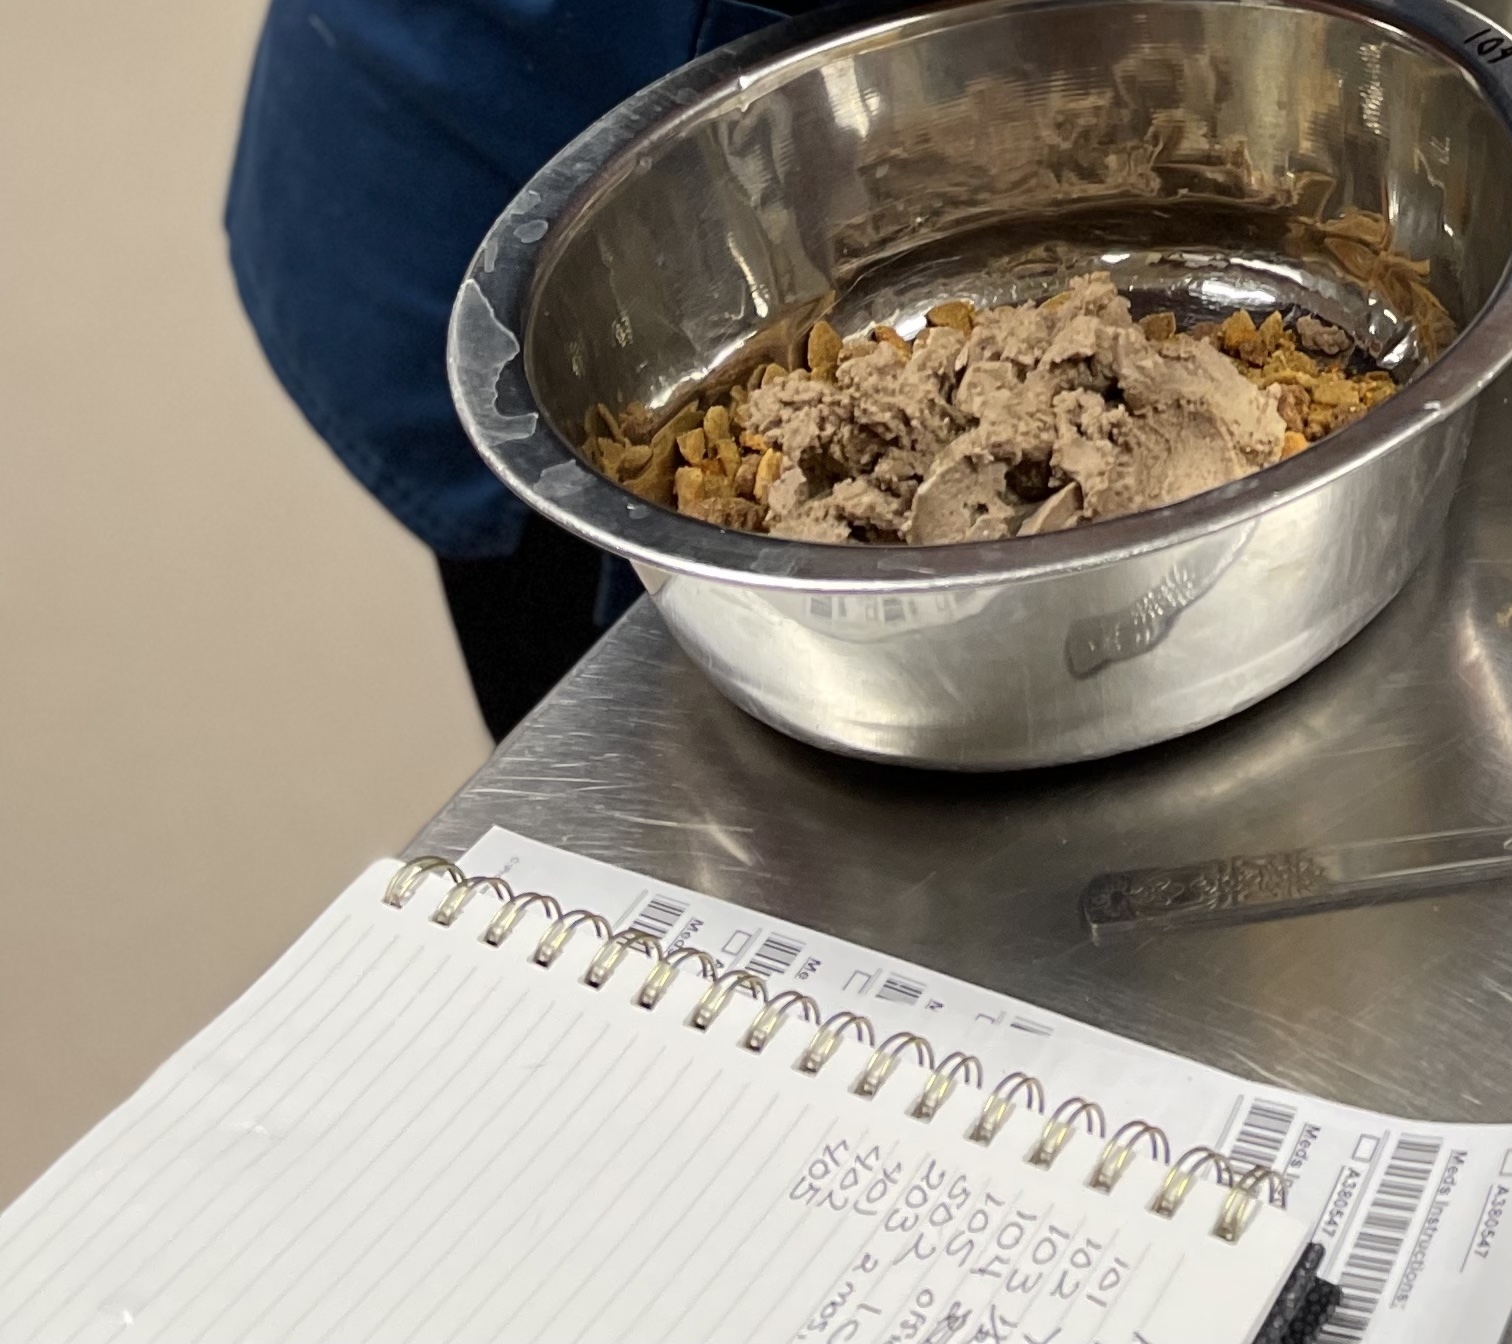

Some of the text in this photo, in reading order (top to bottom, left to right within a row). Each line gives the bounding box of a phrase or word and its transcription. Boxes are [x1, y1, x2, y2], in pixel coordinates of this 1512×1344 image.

[789, 1139, 849, 1205] 405
[816, 1145, 880, 1211] 402
[1289, 1122, 1322, 1169] Meds
[1438, 1149, 1470, 1197] Meds
[885, 1159, 946, 1232] 203
[892, 1173, 971, 1266] 502
[945, 1192, 1006, 1268] 105
[1321, 1165, 1361, 1239] A380547
[1473, 1183, 1511, 1260] A380547
[969, 1209, 1037, 1279] 104
[1006, 1224, 1070, 1294] 103
[1050, 1237, 1102, 1300] 102
[1086, 1255, 1130, 1309] 101
